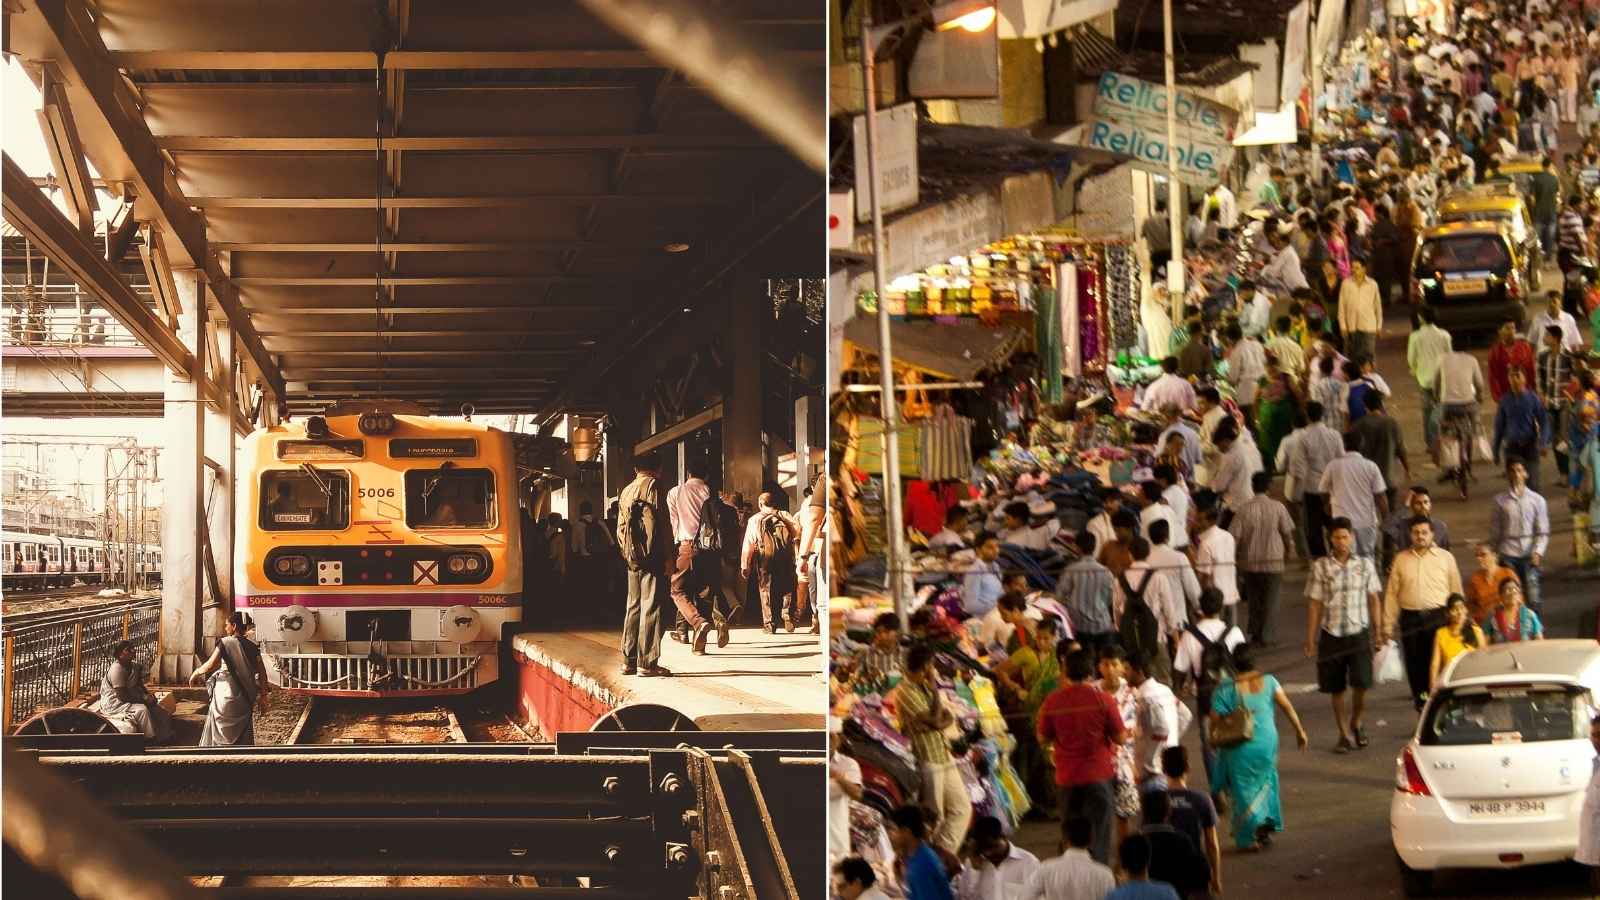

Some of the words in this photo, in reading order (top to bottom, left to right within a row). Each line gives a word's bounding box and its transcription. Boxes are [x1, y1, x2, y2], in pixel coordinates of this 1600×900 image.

[1099, 71, 1219, 125] Reliable
[358, 488, 394, 498] 5006
[249, 596, 278, 606] 5006C
[479, 595, 507, 604] 5006C
